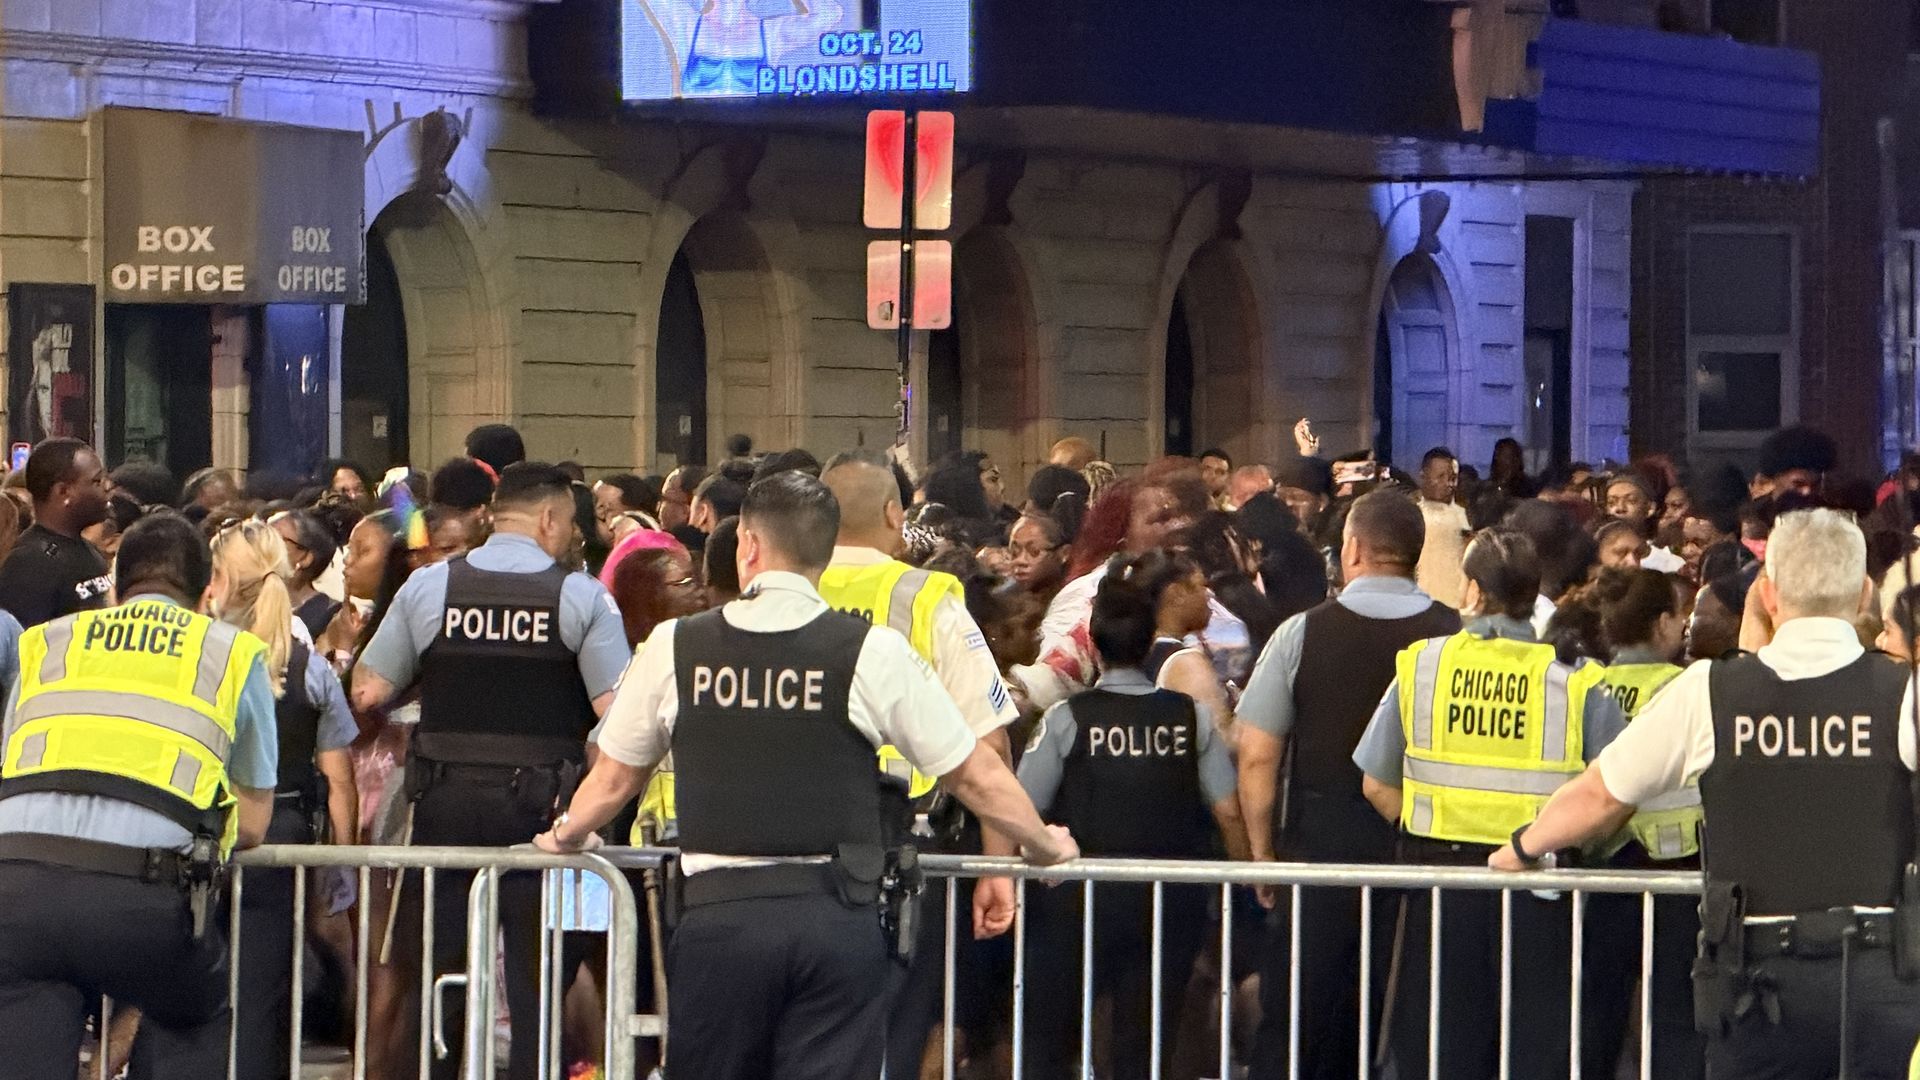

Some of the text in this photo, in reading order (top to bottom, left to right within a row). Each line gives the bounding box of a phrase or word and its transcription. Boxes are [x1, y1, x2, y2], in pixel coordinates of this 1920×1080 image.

[819, 30, 923, 56] OCT. 24
[758, 61, 956, 94] BLONDSHELL
[138, 225, 215, 252] BOX
[292, 226, 331, 253] BOX
[111, 263, 246, 292] OFFICE
[278, 265, 347, 293] OFFICE
[84, 617, 187, 658] POLICE
[446, 607, 550, 642] POLICE
[693, 665, 825, 711] POLICE
[1451, 668, 1529, 705] CHICAGO
[1448, 703, 1527, 740] POLICE
[1734, 715, 1872, 757] POLICE
[1089, 726, 1188, 757] POLICE
